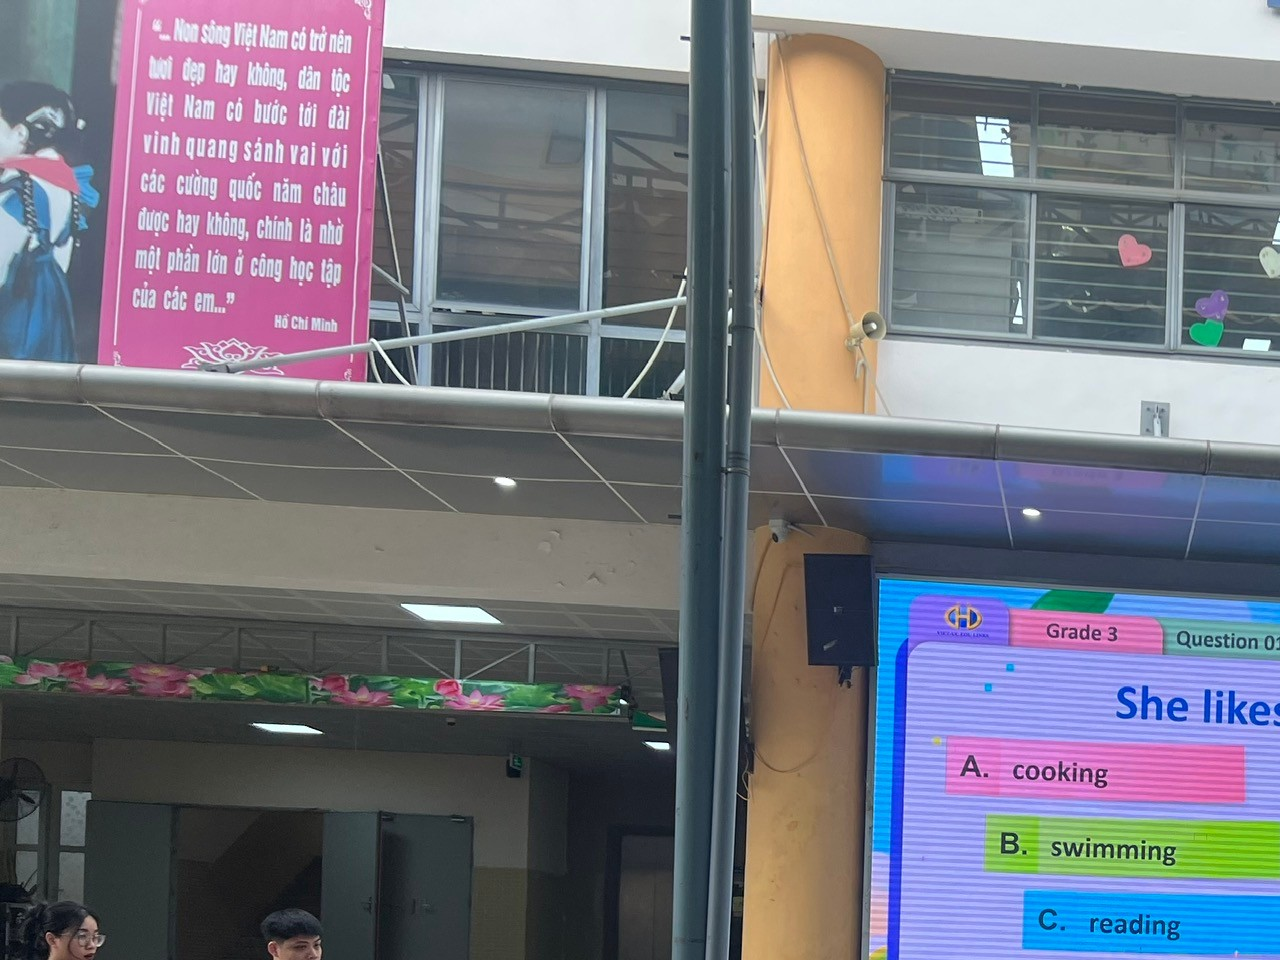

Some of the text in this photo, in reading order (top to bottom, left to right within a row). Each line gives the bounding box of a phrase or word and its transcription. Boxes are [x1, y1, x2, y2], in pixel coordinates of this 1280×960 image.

[173, 17, 199, 43] Non
[200, 19, 231, 48] sông
[233, 21, 257, 52] Việt
[259, 23, 288, 49] Nam
[290, 26, 307, 51] có
[309, 25, 327, 52] trở
[328, 29, 352, 54] nên
[182, 56, 205, 87] đẹp
[214, 59, 238, 87] hay
[247, 62, 287, 92] không,
[298, 65, 321, 91] dân
[330, 67, 351, 97] tộc
[146, 91, 349, 130] Việt Nam có bước tới đài
[143, 131, 348, 169] vinh quang sánh vai với
[140, 168, 346, 208] các cường quốc năm châu
[137, 207, 344, 245] được hay không, chính là nhờ
[134, 244, 342, 288] một phần lớn ở công học tập
[132, 281, 157, 309] của
[163, 285, 187, 311] các
[274, 313, 338, 333] Hồ Chí Minh
[1045, 622, 1118, 642] Grade 3
[1176, 629, 1259, 651] Question
[1116, 686, 1190, 725] She
[959, 753, 1109, 791] A. cooking
[1000, 831, 1177, 868] B. swimming
[1037, 908, 1181, 942] C. reading
